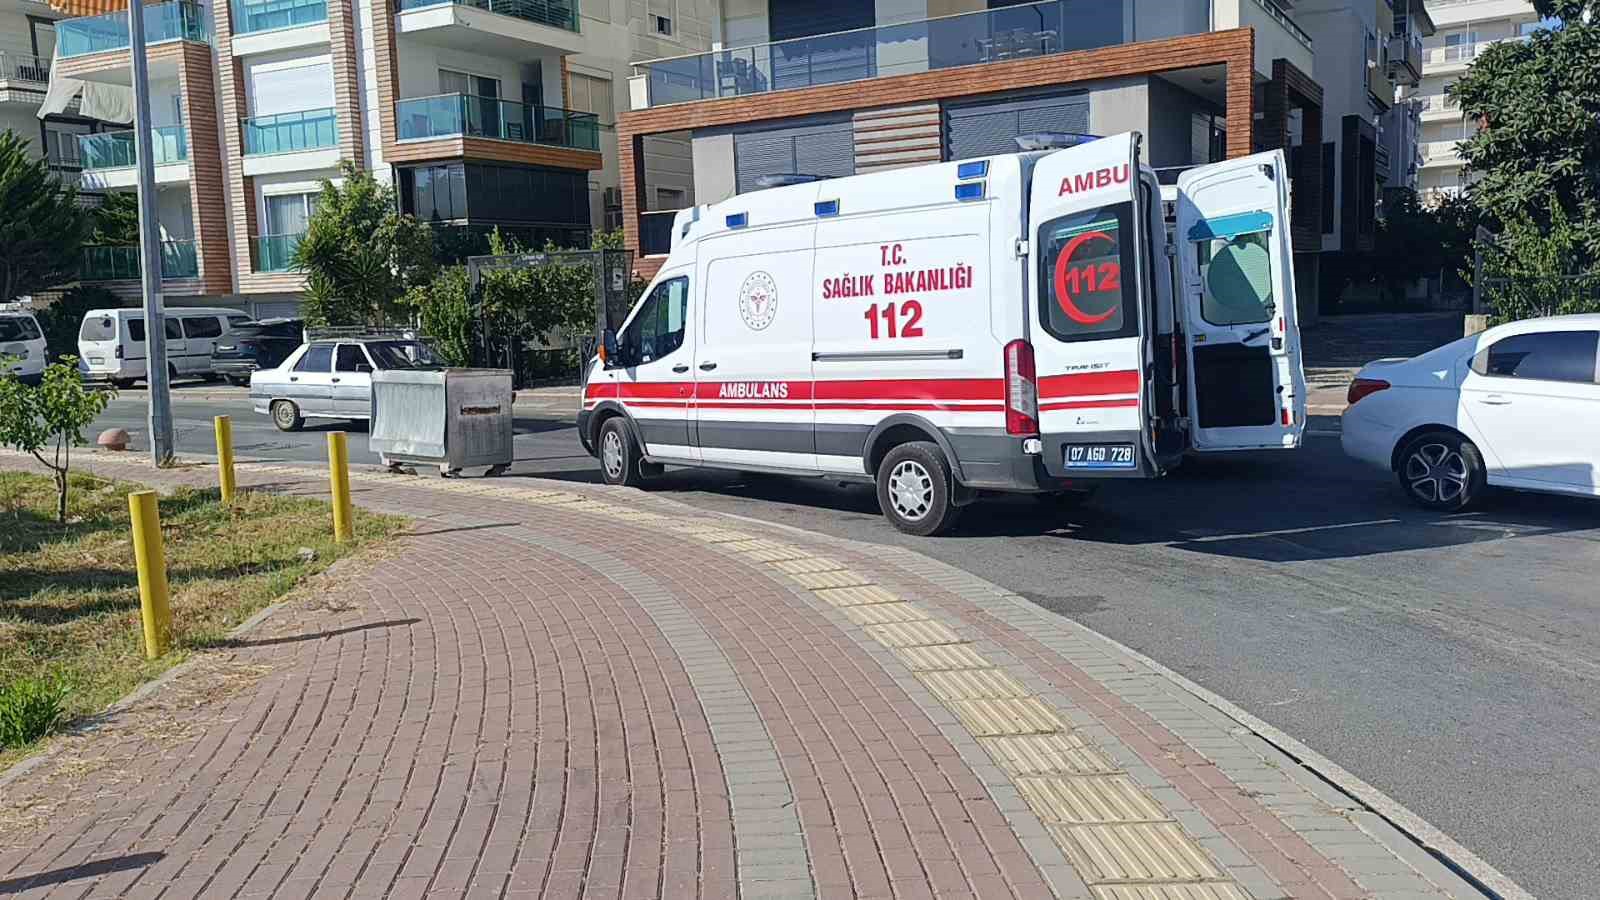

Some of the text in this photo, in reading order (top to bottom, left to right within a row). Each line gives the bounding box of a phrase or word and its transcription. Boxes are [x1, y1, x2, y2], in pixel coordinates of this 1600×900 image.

[1058, 163, 1130, 197] AMBU
[880, 243, 907, 266] T.C.
[823, 262, 972, 299] SAĞLIK BAKANLIĞI
[1065, 262, 1121, 296] 112
[864, 299, 924, 339] 112
[719, 382, 789, 399] AMBULANS
[1071, 447, 1083, 461] 07
[1111, 447, 1132, 462] 728
